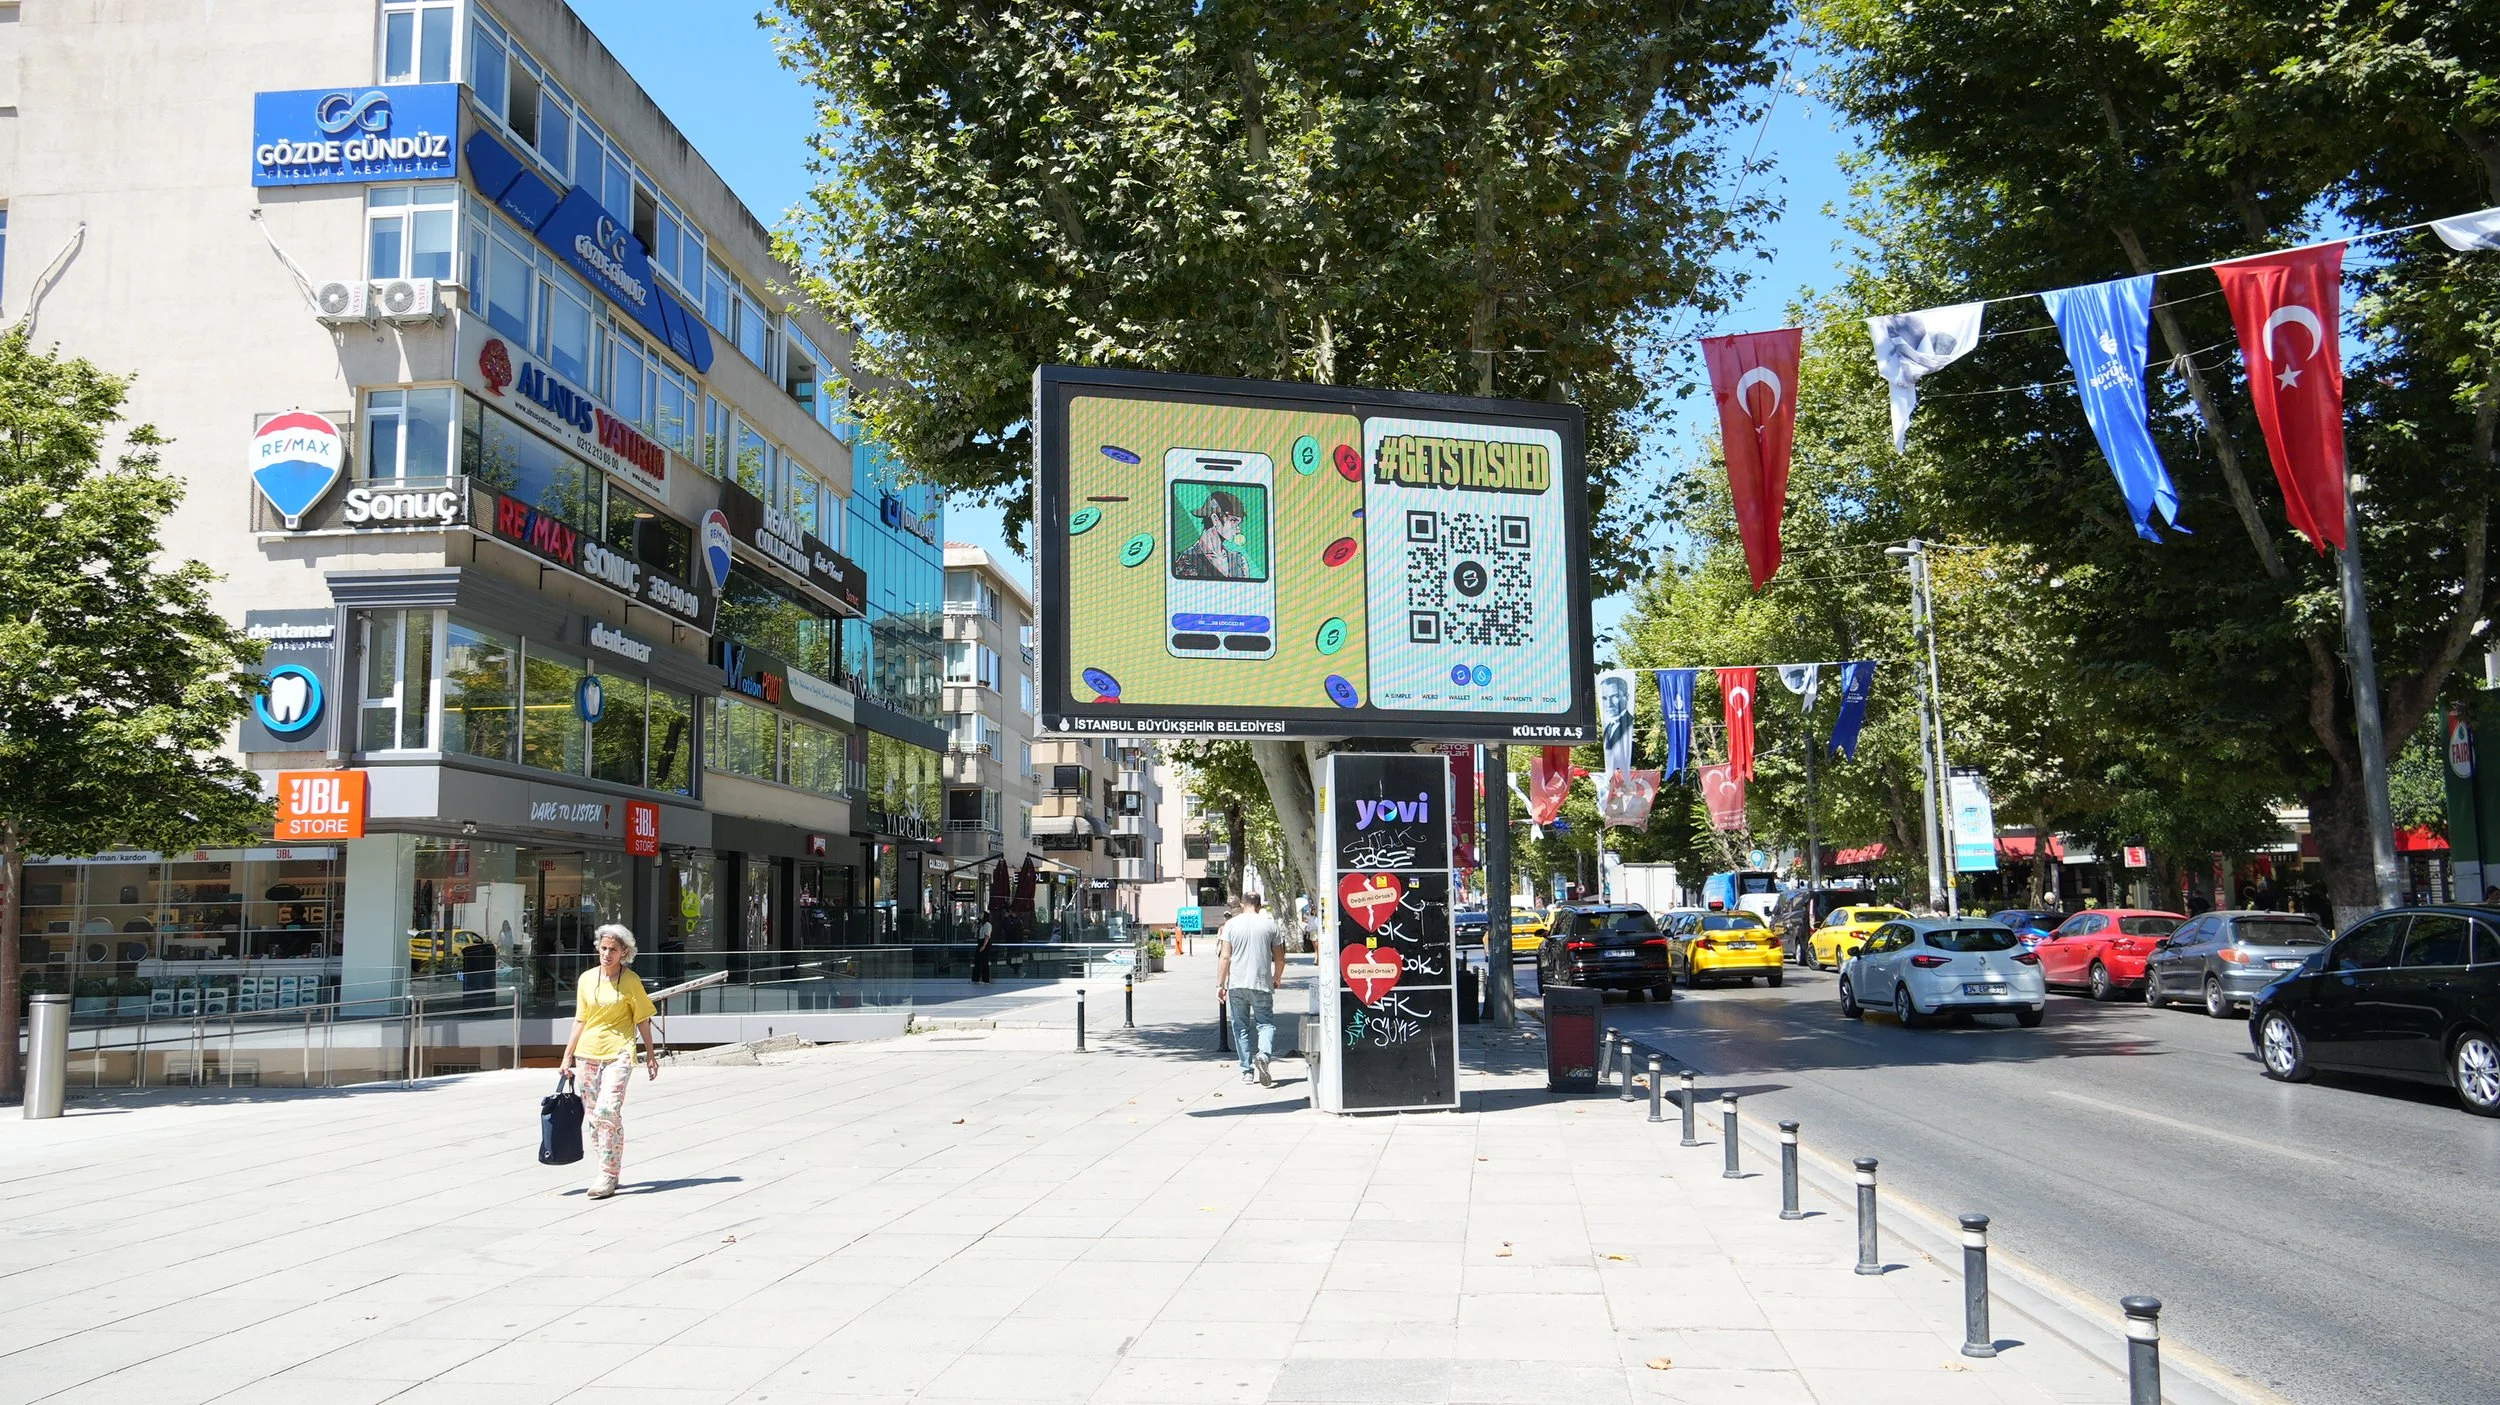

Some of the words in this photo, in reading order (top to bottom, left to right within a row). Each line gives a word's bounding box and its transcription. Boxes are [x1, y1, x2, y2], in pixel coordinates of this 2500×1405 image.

[256, 138, 342, 166] GÖZDE
[344, 131, 449, 162] GÜNDÜZ
[267, 167, 329, 179] FITSLIM
[336, 167, 345, 177] &
[354, 161, 440, 176] AESTHETIC
[516, 361, 594, 434] ALNUS
[261, 436, 330, 459] RE/MAX
[576, 435, 592, 455] 0212
[1376, 435, 1551, 494] #GETSTASHED
[346, 487, 459, 526] Sonuç
[498, 494, 577, 566] RE/MAX
[763, 502, 805, 552] RE/MAX
[754, 527, 811, 577] COLLECTION
[583, 541, 641, 599] SONUÇ
[247, 622, 335, 639] dentamar
[590, 621, 652, 664] dentamar
[762, 671, 783, 704] POINT
[1074, 717, 1135, 731] İSTANBUL
[1137, 718, 1215, 734] BÜYÜKŞEHİR
[1217, 719, 1286, 733] BELEDİYESİ
[1512, 725, 1561, 738] KÜLTÜR
[1563, 726, 1583, 740] A.Ş
[2452, 741, 2471, 764] FAIR
[290, 777, 349, 815] JBL
[1355, 791, 1429, 831] yovi
[289, 818, 349, 834] STORE
[530, 801, 558, 822] DARE
[558, 804, 570, 820] TO
[570, 803, 602, 823] LISTEN
[635, 807, 656, 837] JBL
[193, 850, 209, 861] JBL
[276, 848, 293, 859] JBL
[635, 839, 655, 853] STORE
